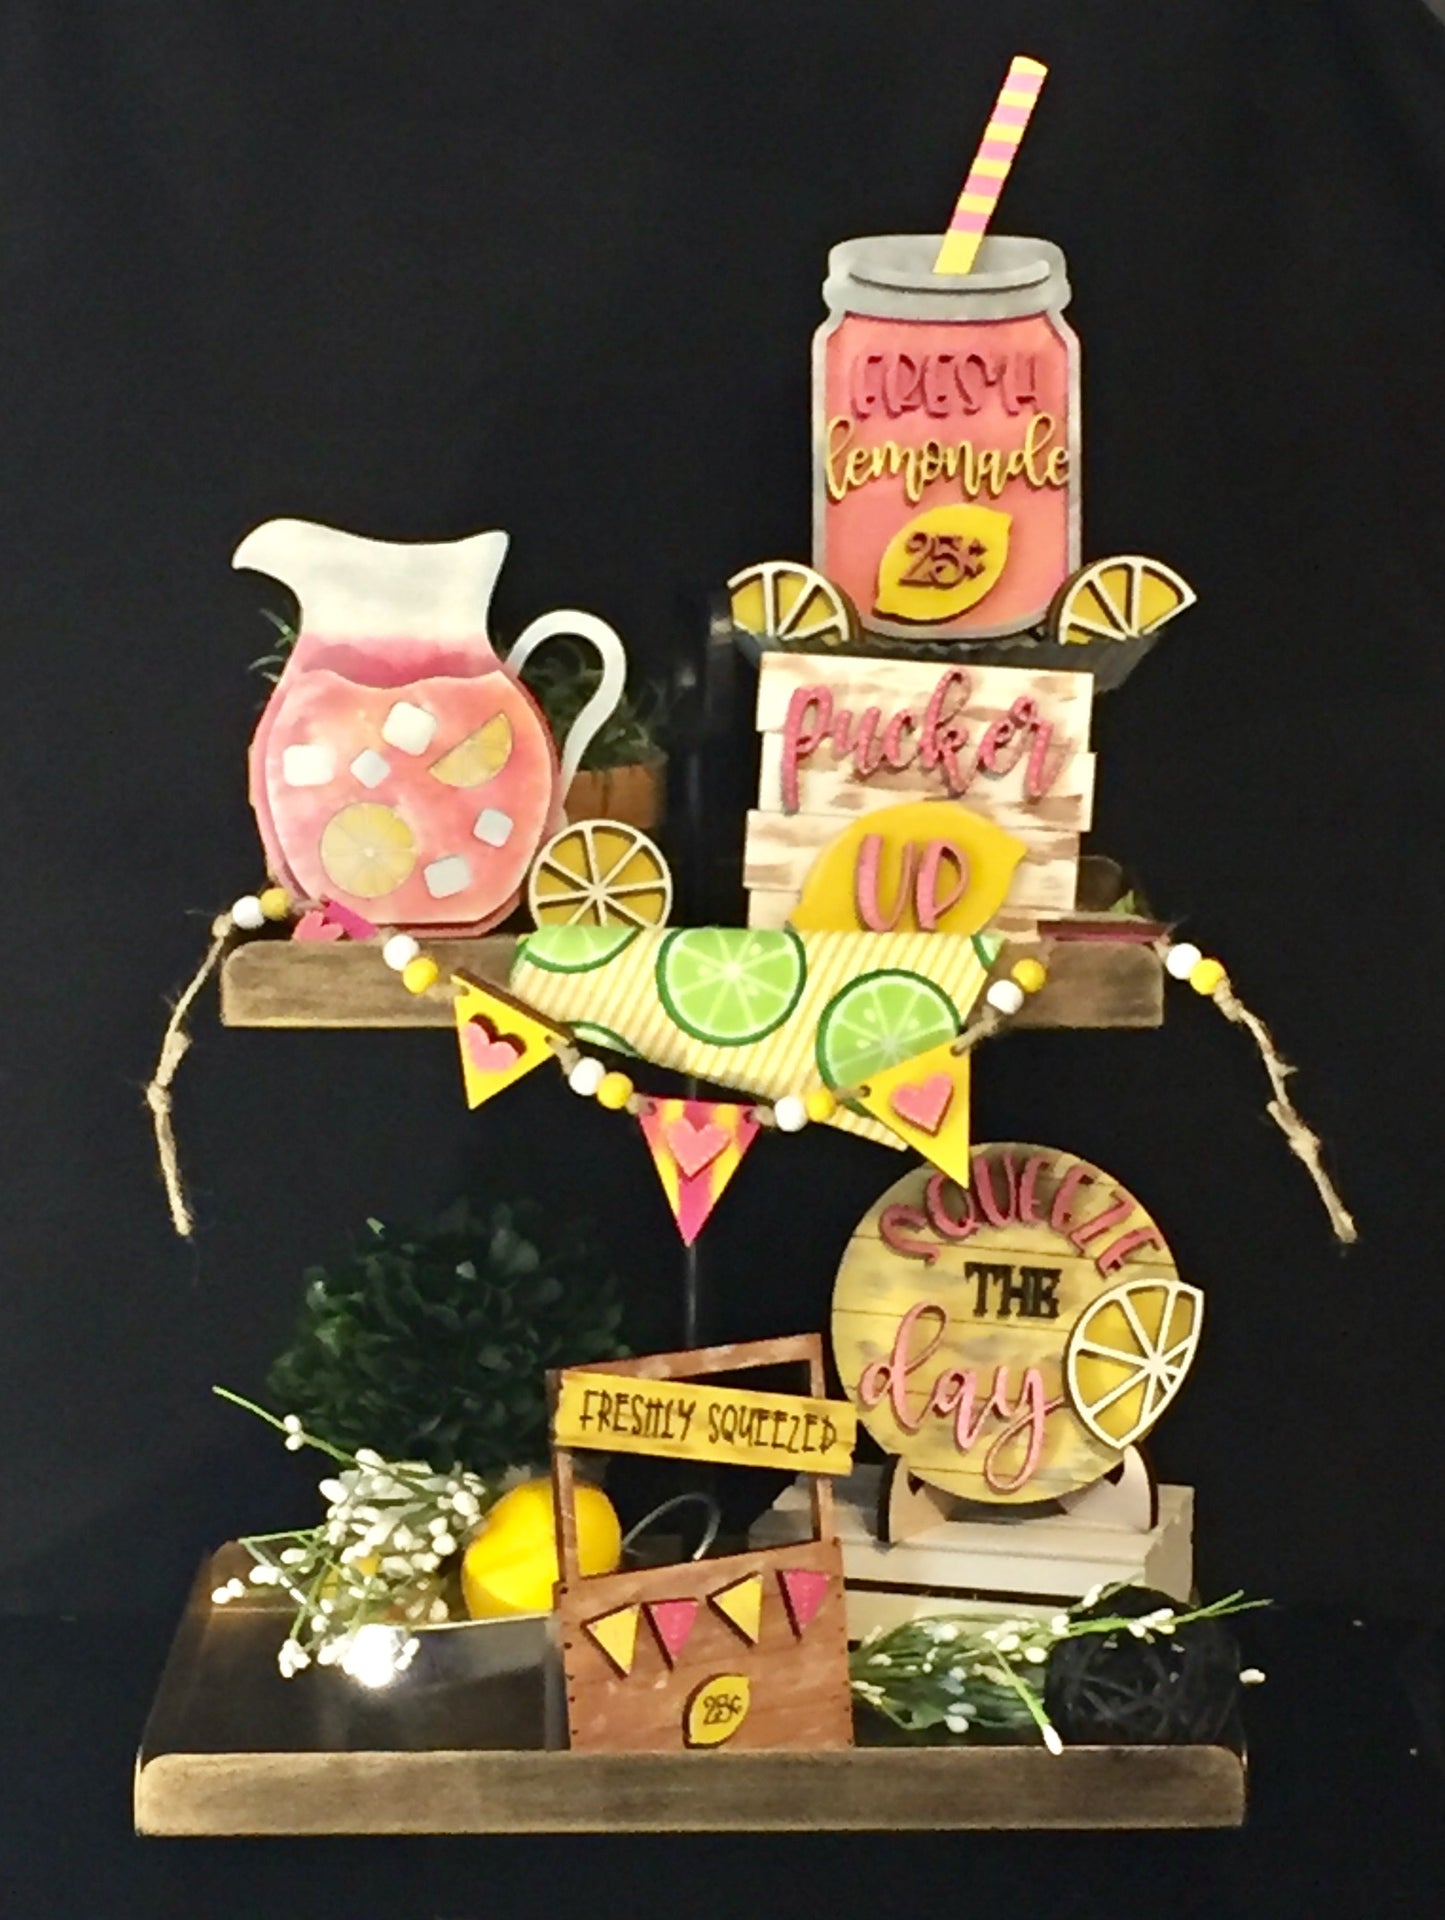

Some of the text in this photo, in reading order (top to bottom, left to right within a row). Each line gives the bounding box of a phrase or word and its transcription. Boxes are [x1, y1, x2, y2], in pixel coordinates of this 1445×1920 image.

[825, 411, 1070, 504] lemonade
[857, 833, 971, 932] UP
[879, 1152, 1163, 1277] SQUEEZE
[964, 1261, 1063, 1320] THE
[578, 1389, 837, 1455] FRESHLY SQUEEZED
[859, 1300, 1066, 1495] day
